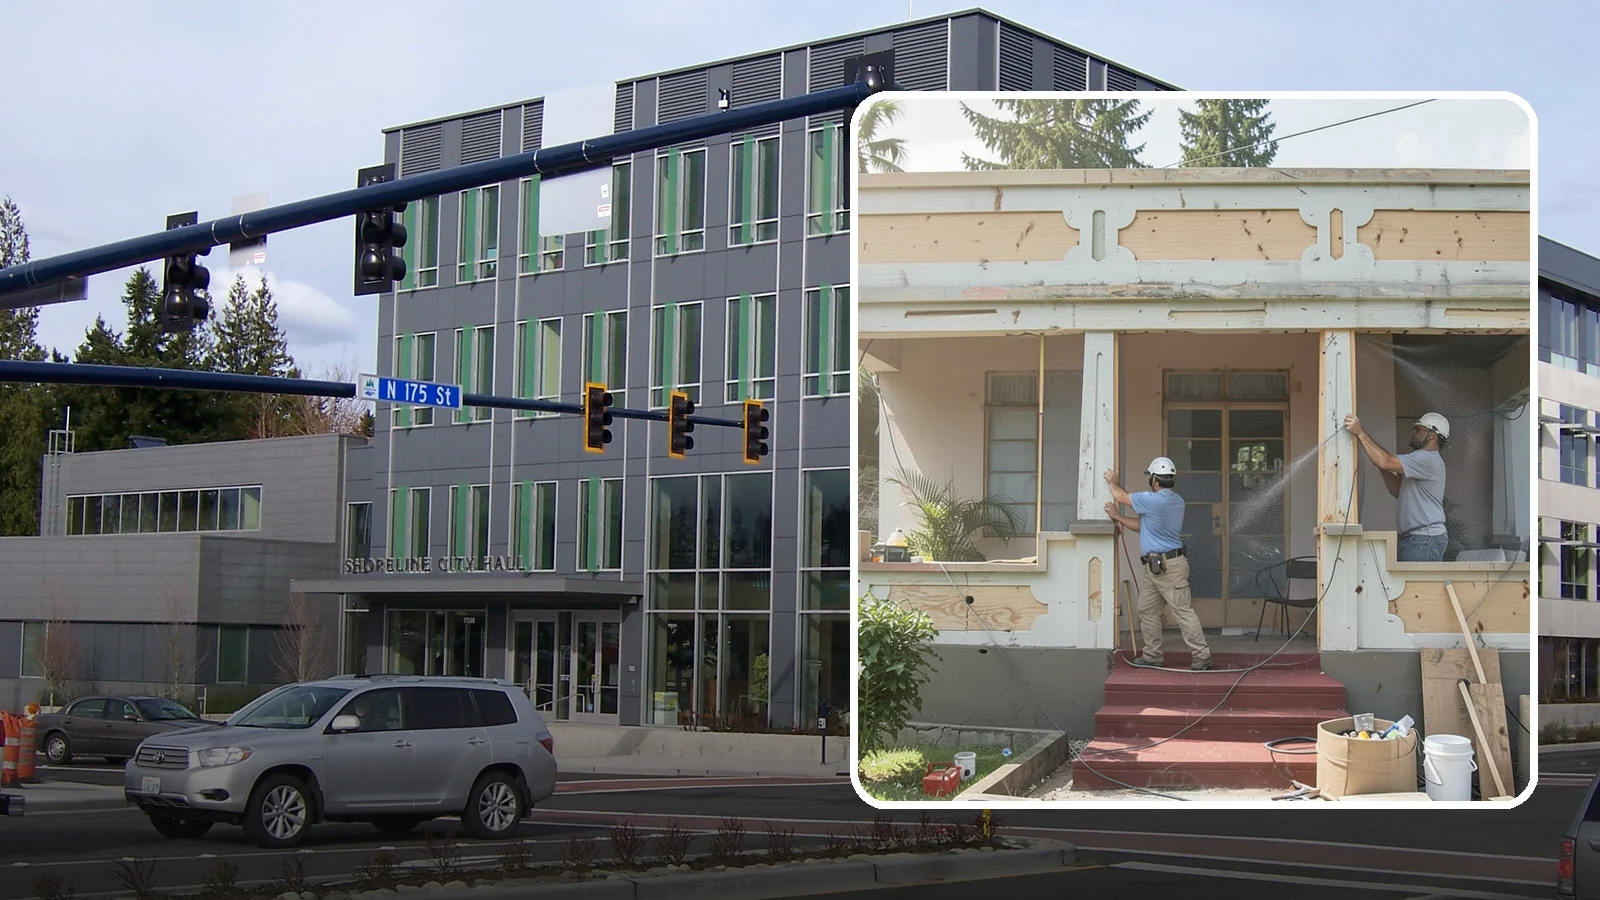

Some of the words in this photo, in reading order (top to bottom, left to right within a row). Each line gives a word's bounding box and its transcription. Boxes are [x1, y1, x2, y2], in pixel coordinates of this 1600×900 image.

[387, 381, 396, 400] N
[405, 382, 427, 403] 175
[436, 387, 451, 406] St
[344, 557, 433, 574] SHORELINE
[438, 556, 476, 572] CITY
[484, 555, 526, 571] HALL
